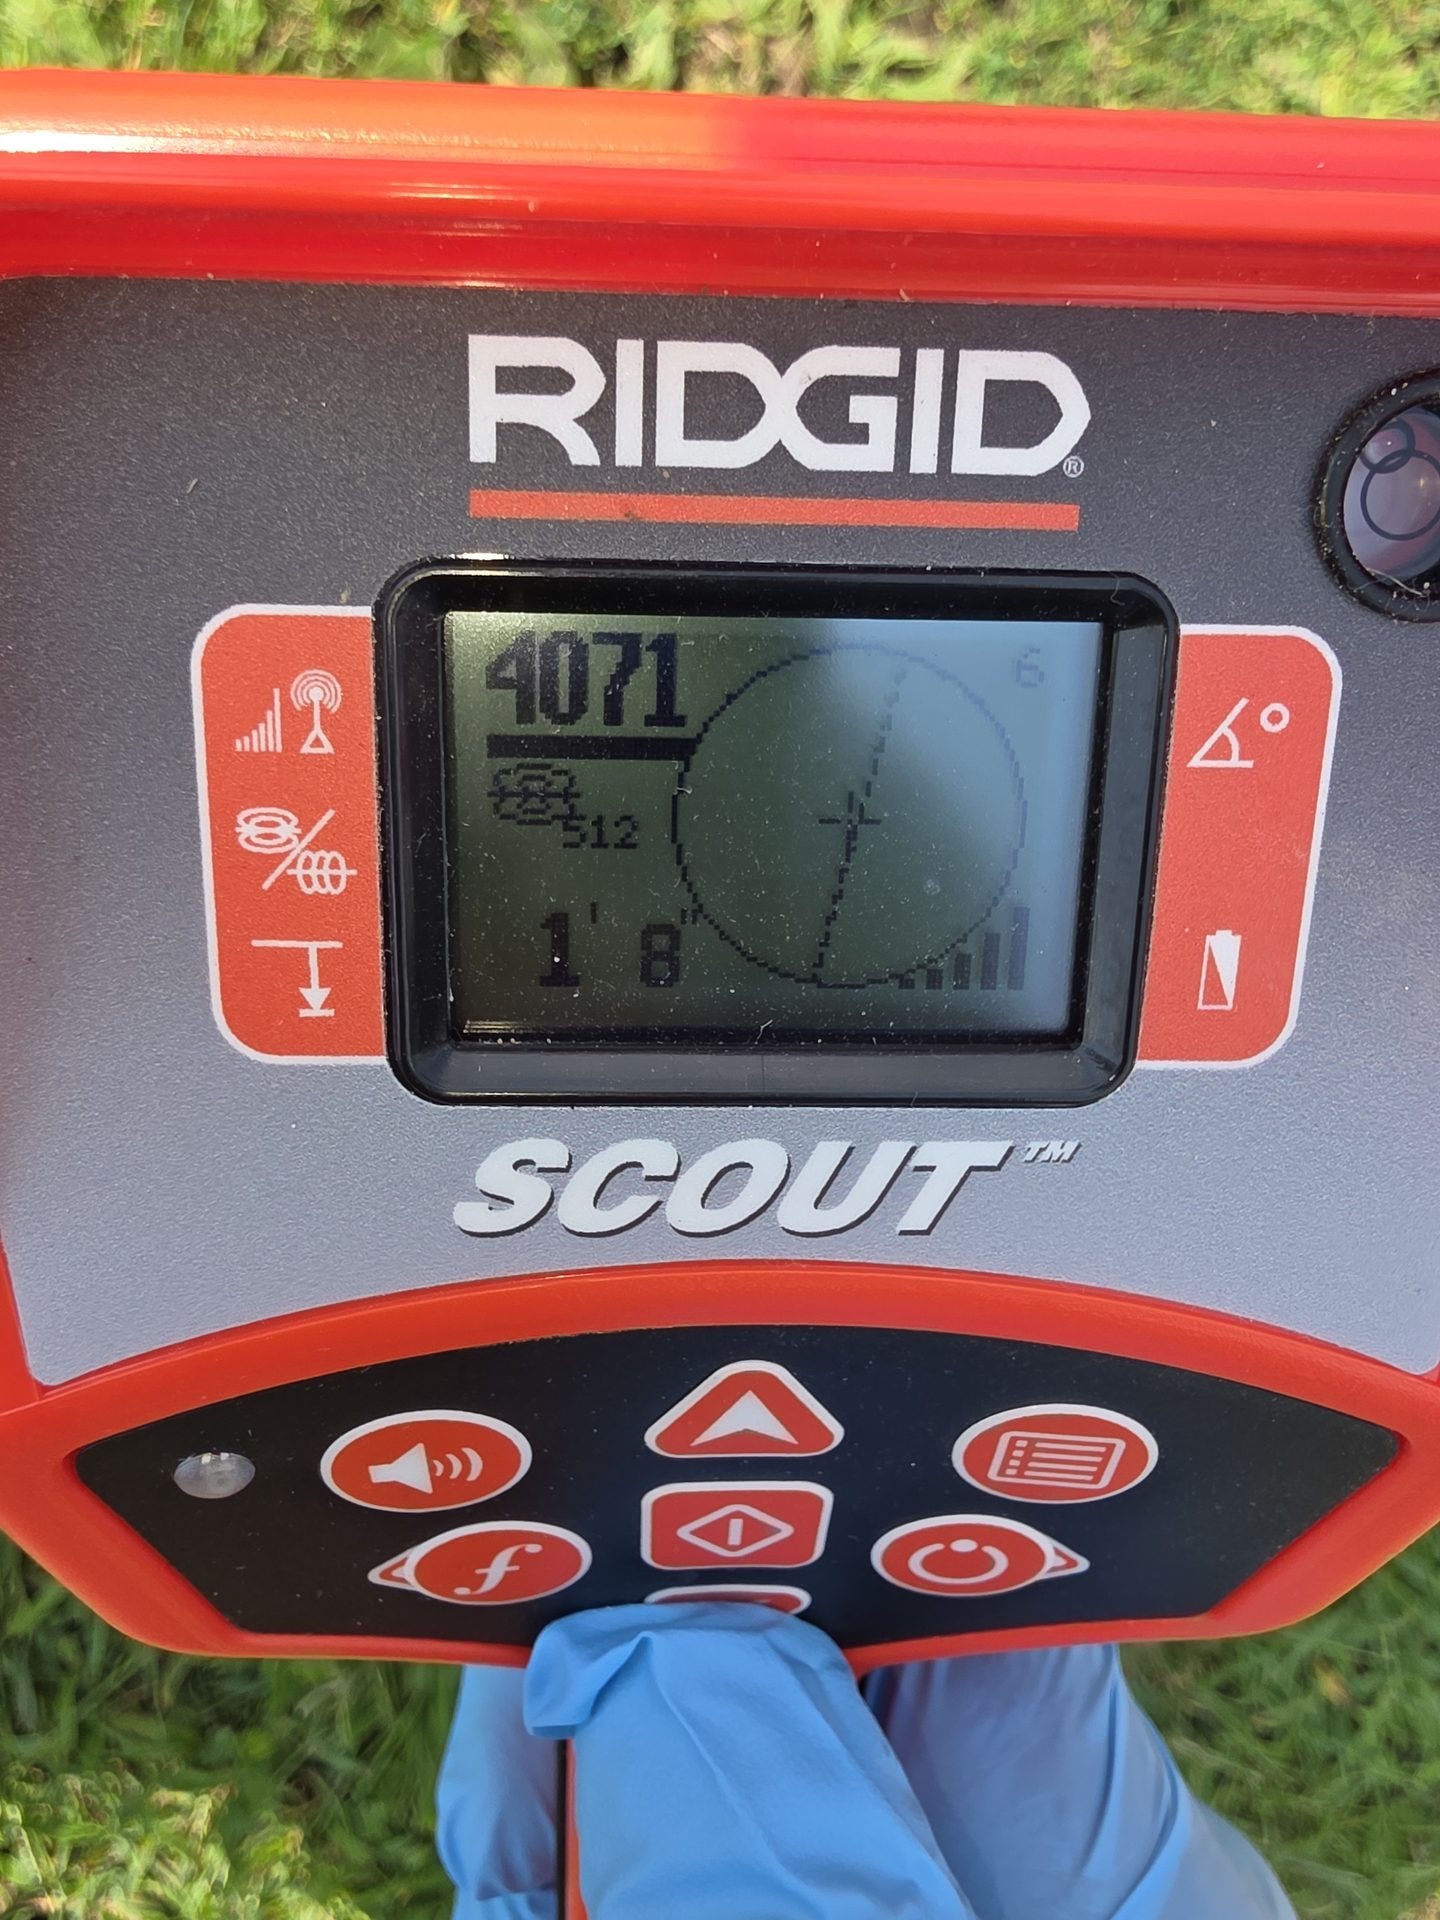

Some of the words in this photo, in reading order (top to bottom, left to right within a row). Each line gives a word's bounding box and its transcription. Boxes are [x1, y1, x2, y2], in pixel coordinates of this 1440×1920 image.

[486, 630, 687, 726] 4071
[1016, 648, 1045, 688] 6
[562, 815, 639, 848] 512
